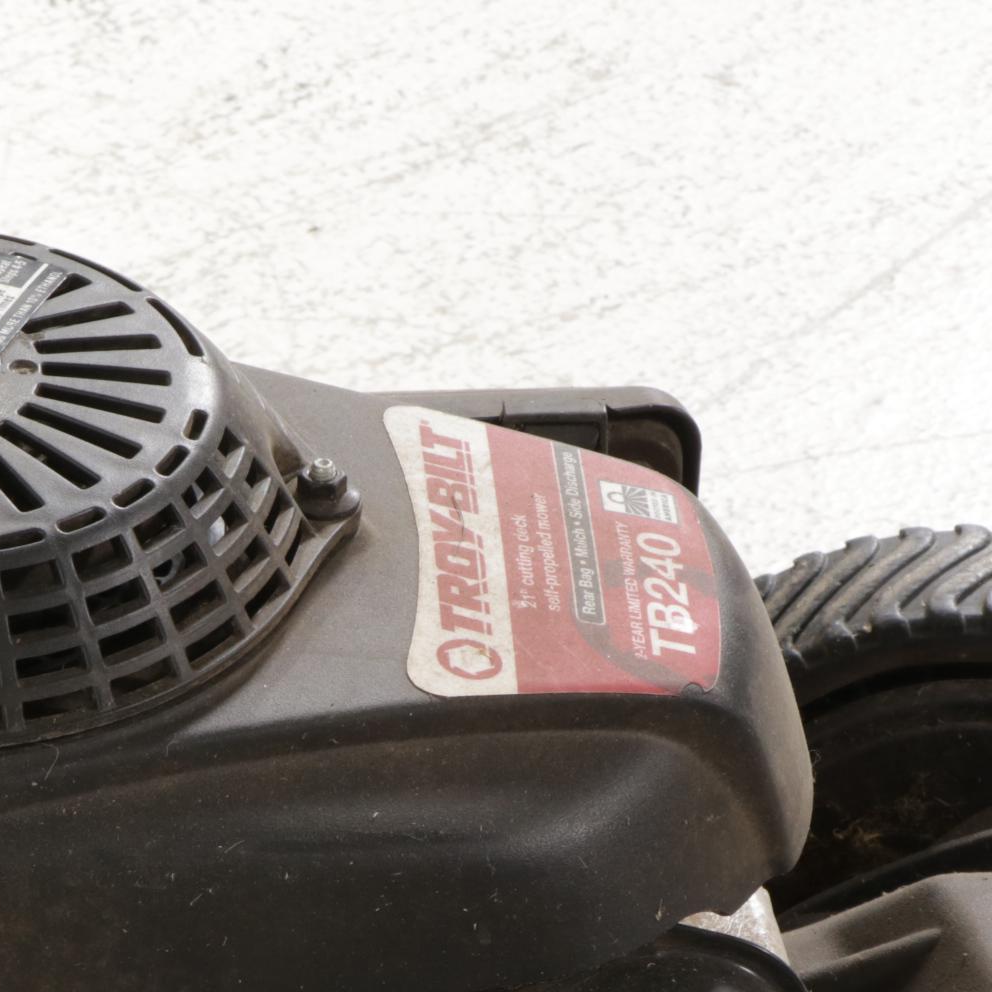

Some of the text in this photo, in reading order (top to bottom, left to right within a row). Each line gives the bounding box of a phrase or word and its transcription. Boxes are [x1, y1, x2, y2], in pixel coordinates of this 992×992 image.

[419, 424, 492, 636] TROY-BILT
[512, 514, 531, 542] deck
[517, 546, 535, 586] cutting
[534, 493, 560, 612] self-propelled mower
[562, 451, 597, 616] Rear Bag Mulch Side Discharge
[615, 521, 636, 578] WARRANTY
[625, 579, 642, 621] LIMITED
[636, 532, 699, 656] TB240
